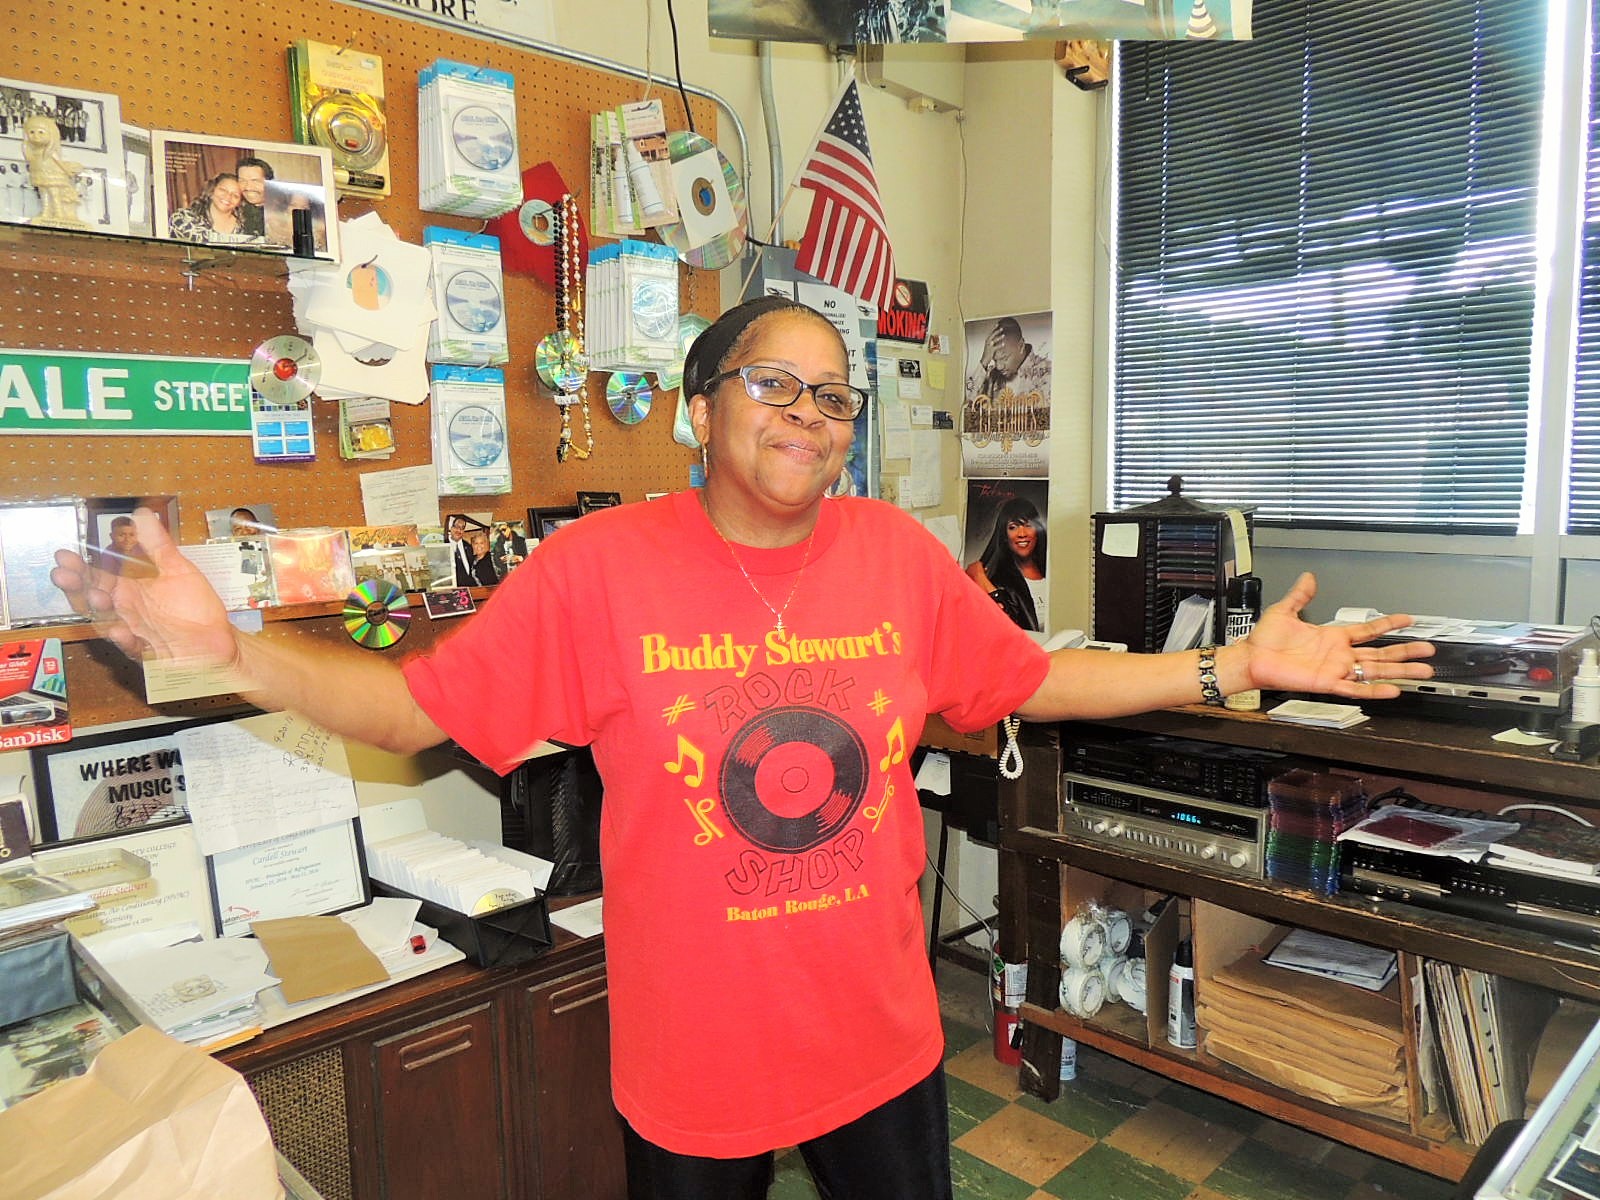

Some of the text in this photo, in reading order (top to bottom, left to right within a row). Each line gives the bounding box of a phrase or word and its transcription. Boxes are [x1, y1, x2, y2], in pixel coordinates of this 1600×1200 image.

[823, 300, 836, 309] NO
[877, 307, 927, 340] MOKING
[0, 364, 250, 420] ALE STREE
[1229, 615, 1252, 626] HOT
[640, 621, 901, 678] Buddy Stewart's
[703, 668, 856, 734] ROCK
[80, 754, 153, 782] WHERE
[108, 774, 186, 804] MUSIC S
[724, 827, 864, 897] SHOP
[725, 883, 870, 922] Baton Rouge, LA
